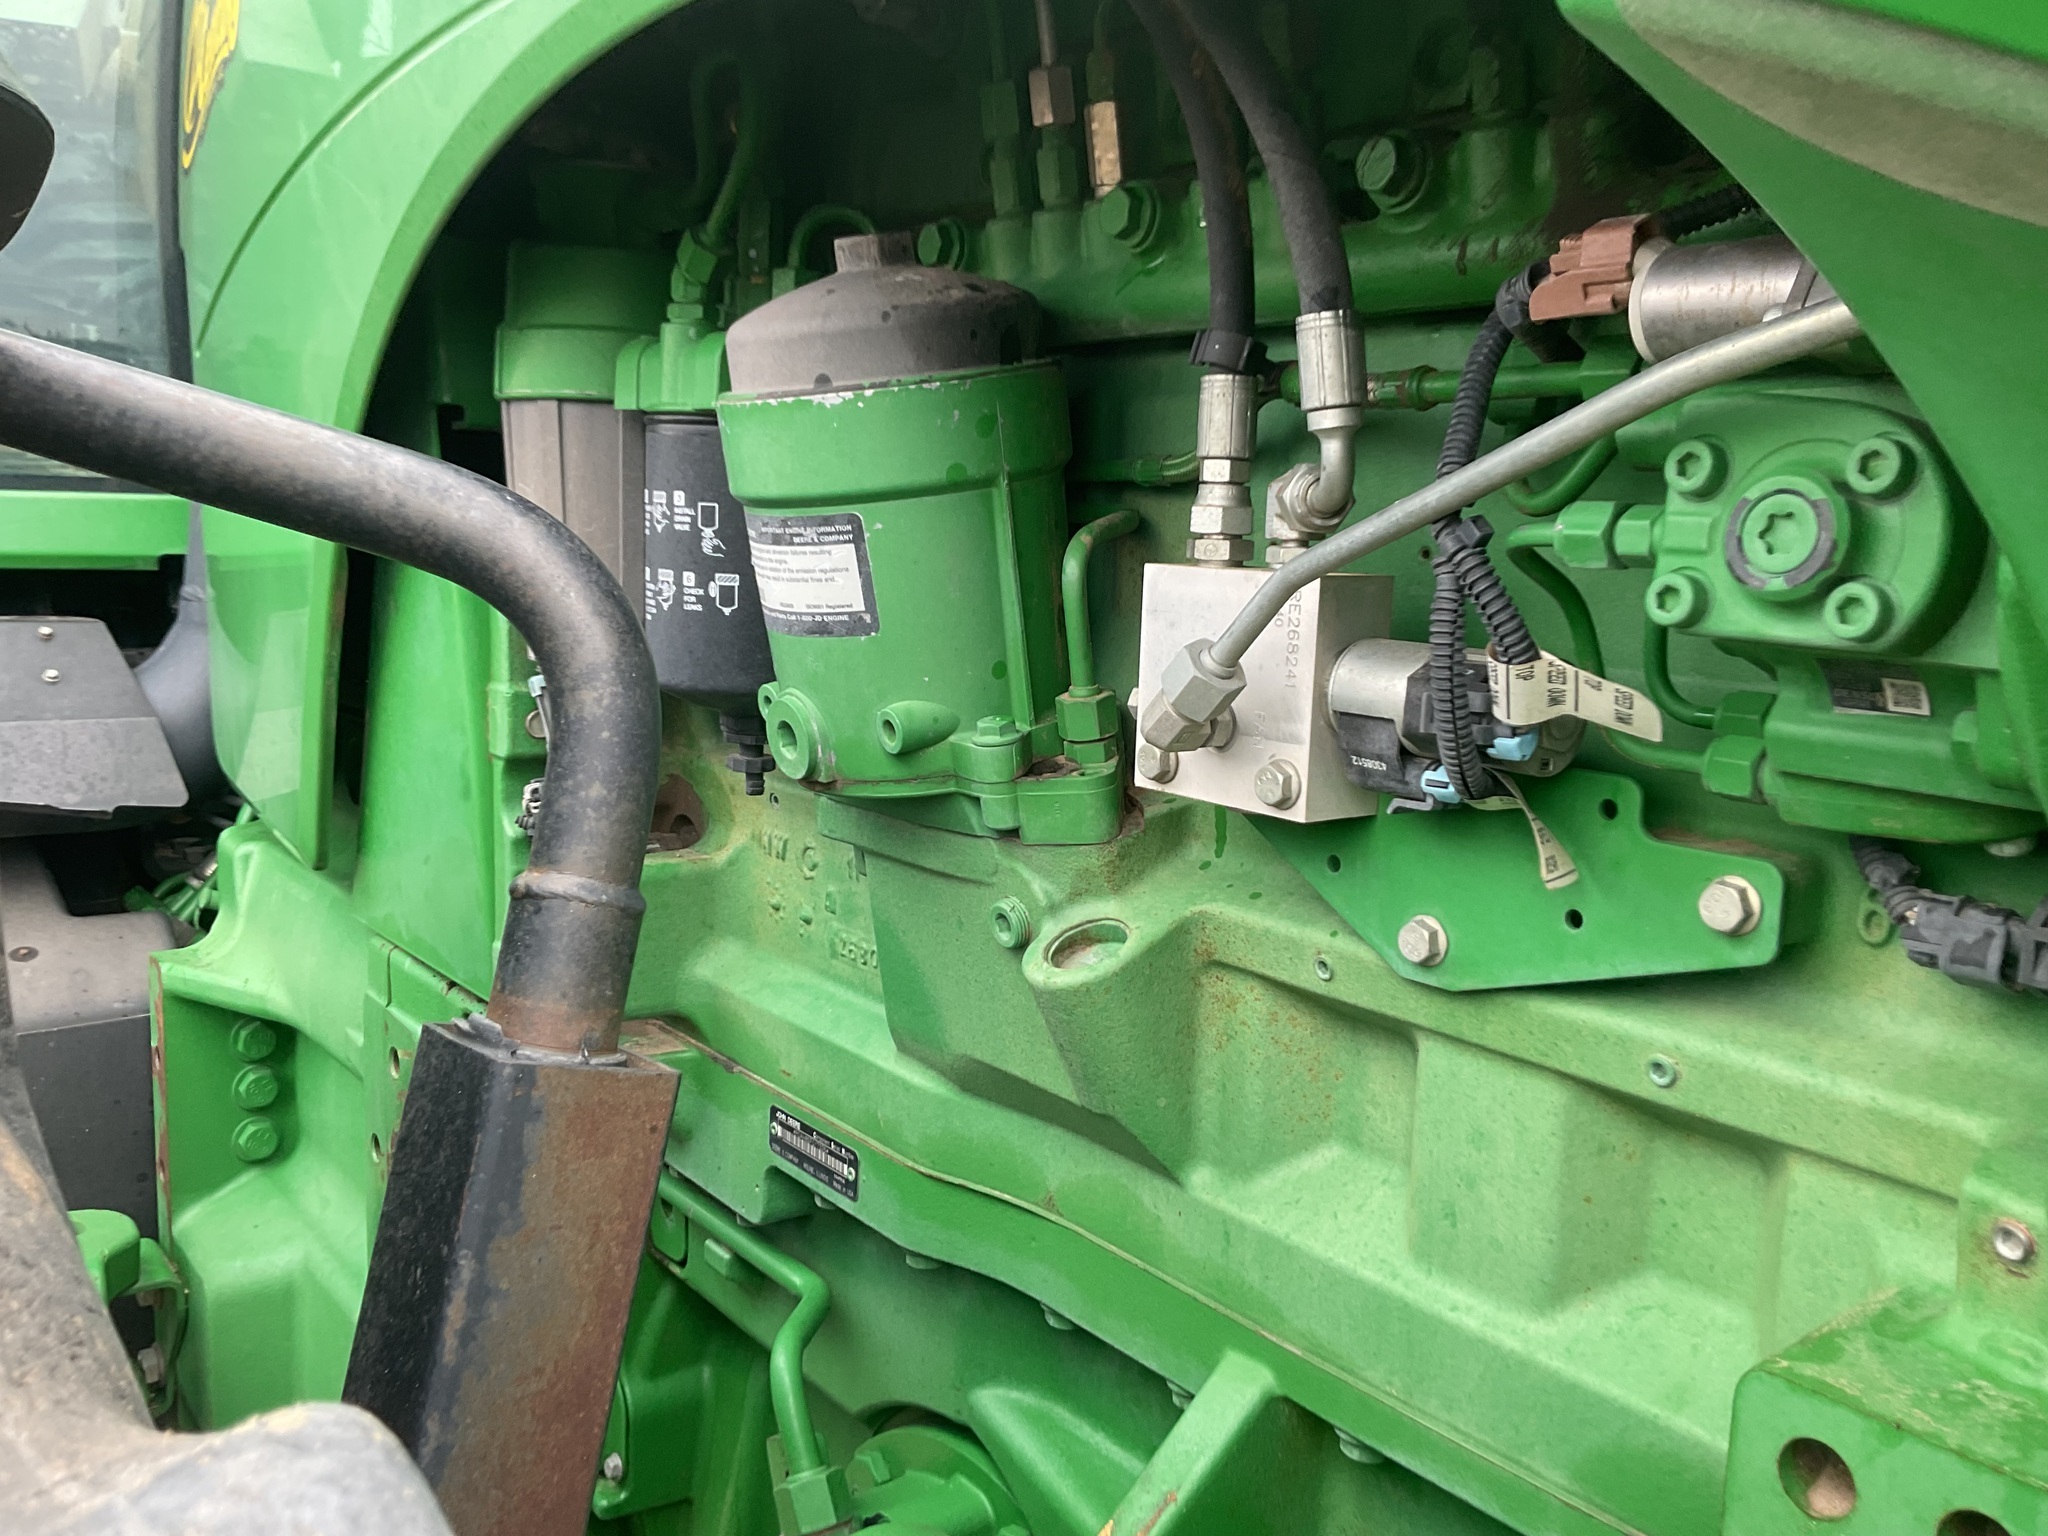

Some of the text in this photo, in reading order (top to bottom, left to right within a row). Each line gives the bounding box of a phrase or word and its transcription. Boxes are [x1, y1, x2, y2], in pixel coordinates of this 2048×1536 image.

[819, 534, 853, 543] COMPANY
[683, 587, 704, 595] CHECK
[683, 595, 697, 603] FOR
[683, 603, 703, 611] LEAKS
[823, 614, 850, 622] ENGINE
[1515, 664, 1536, 682] TOP
[1614, 688, 1635, 710] SPEED
